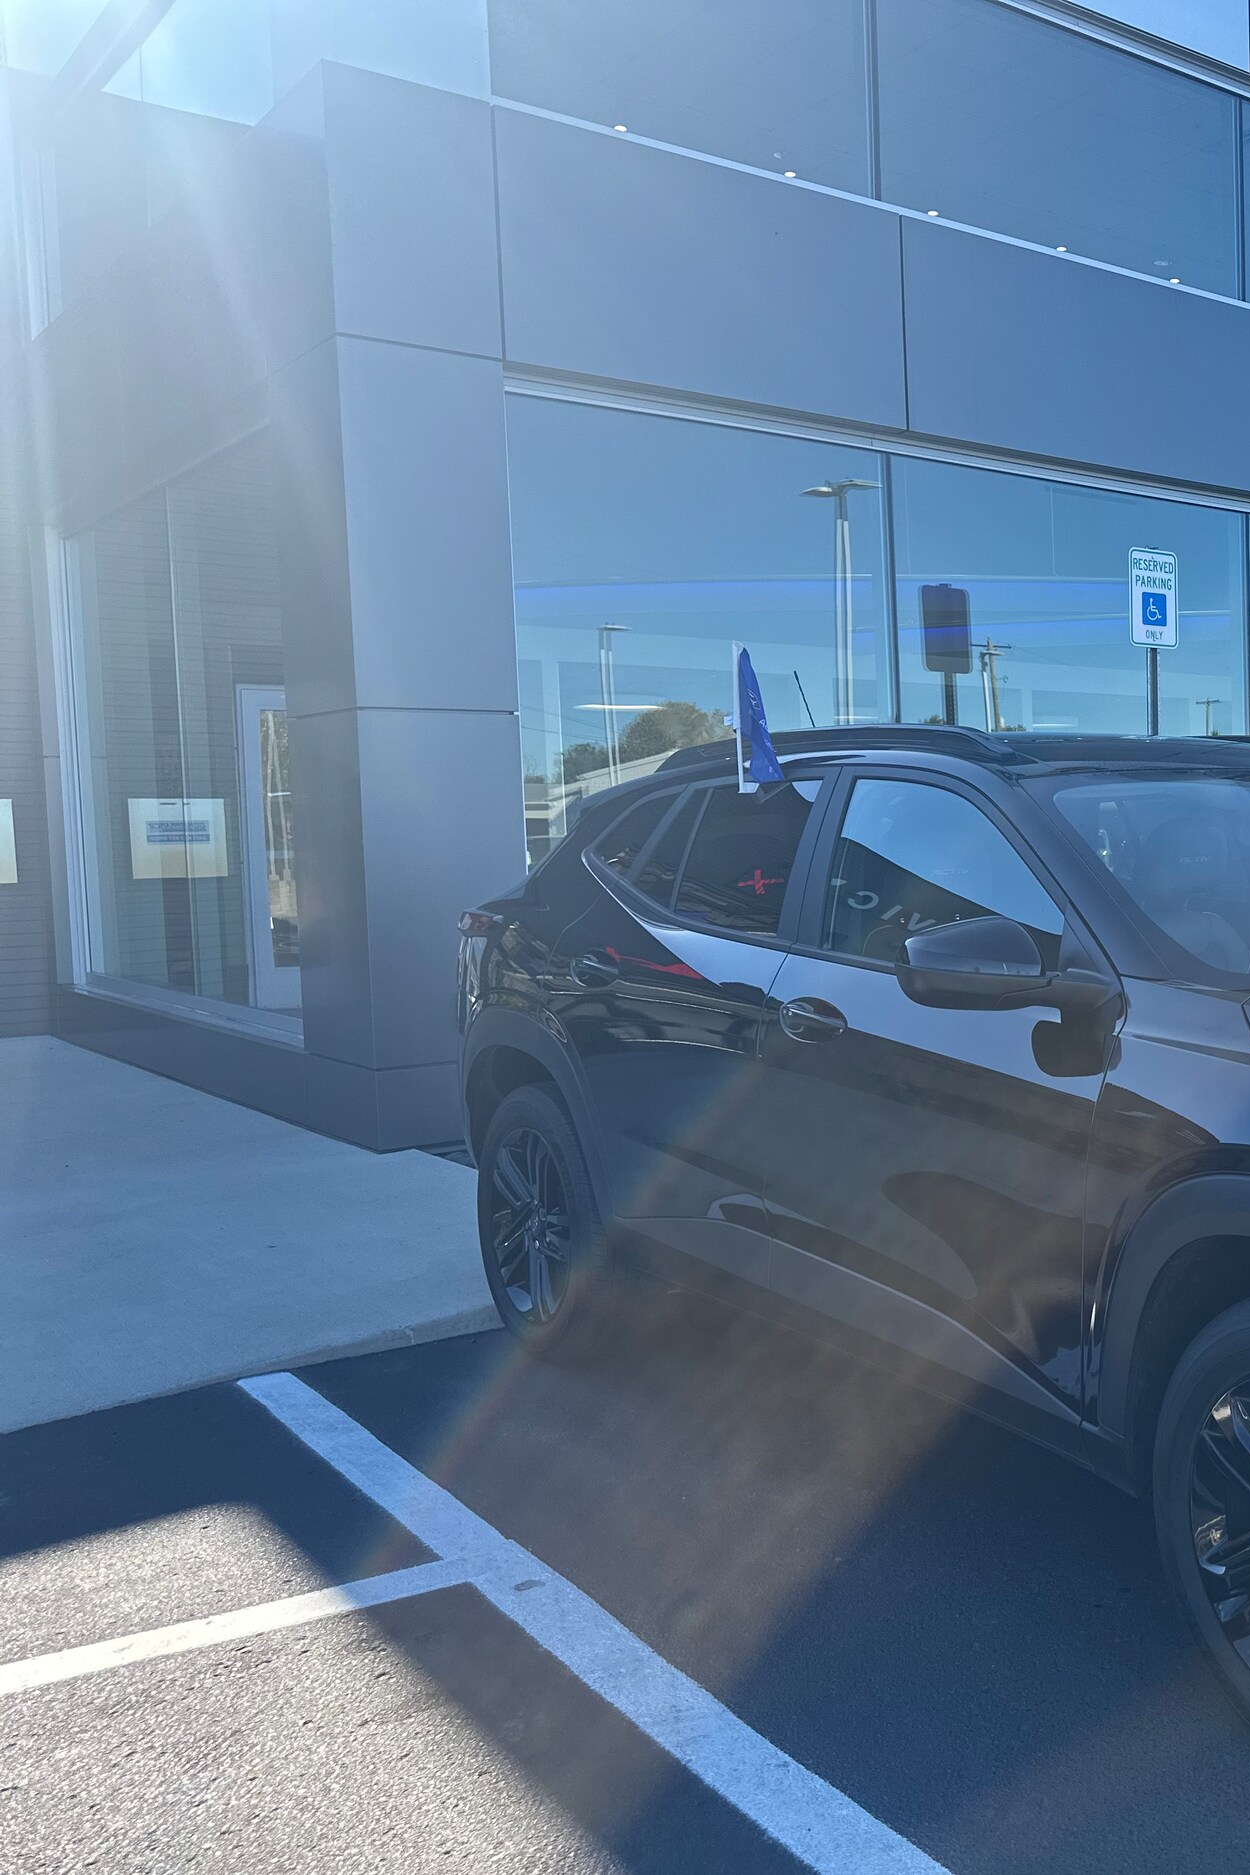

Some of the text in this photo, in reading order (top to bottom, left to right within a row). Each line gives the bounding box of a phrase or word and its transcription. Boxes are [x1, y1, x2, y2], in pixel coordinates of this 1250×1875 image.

[1133, 557, 1174, 575] RESERVED
[1135, 574, 1172, 590] PARKING
[1145, 629, 1164, 641] ONLY
